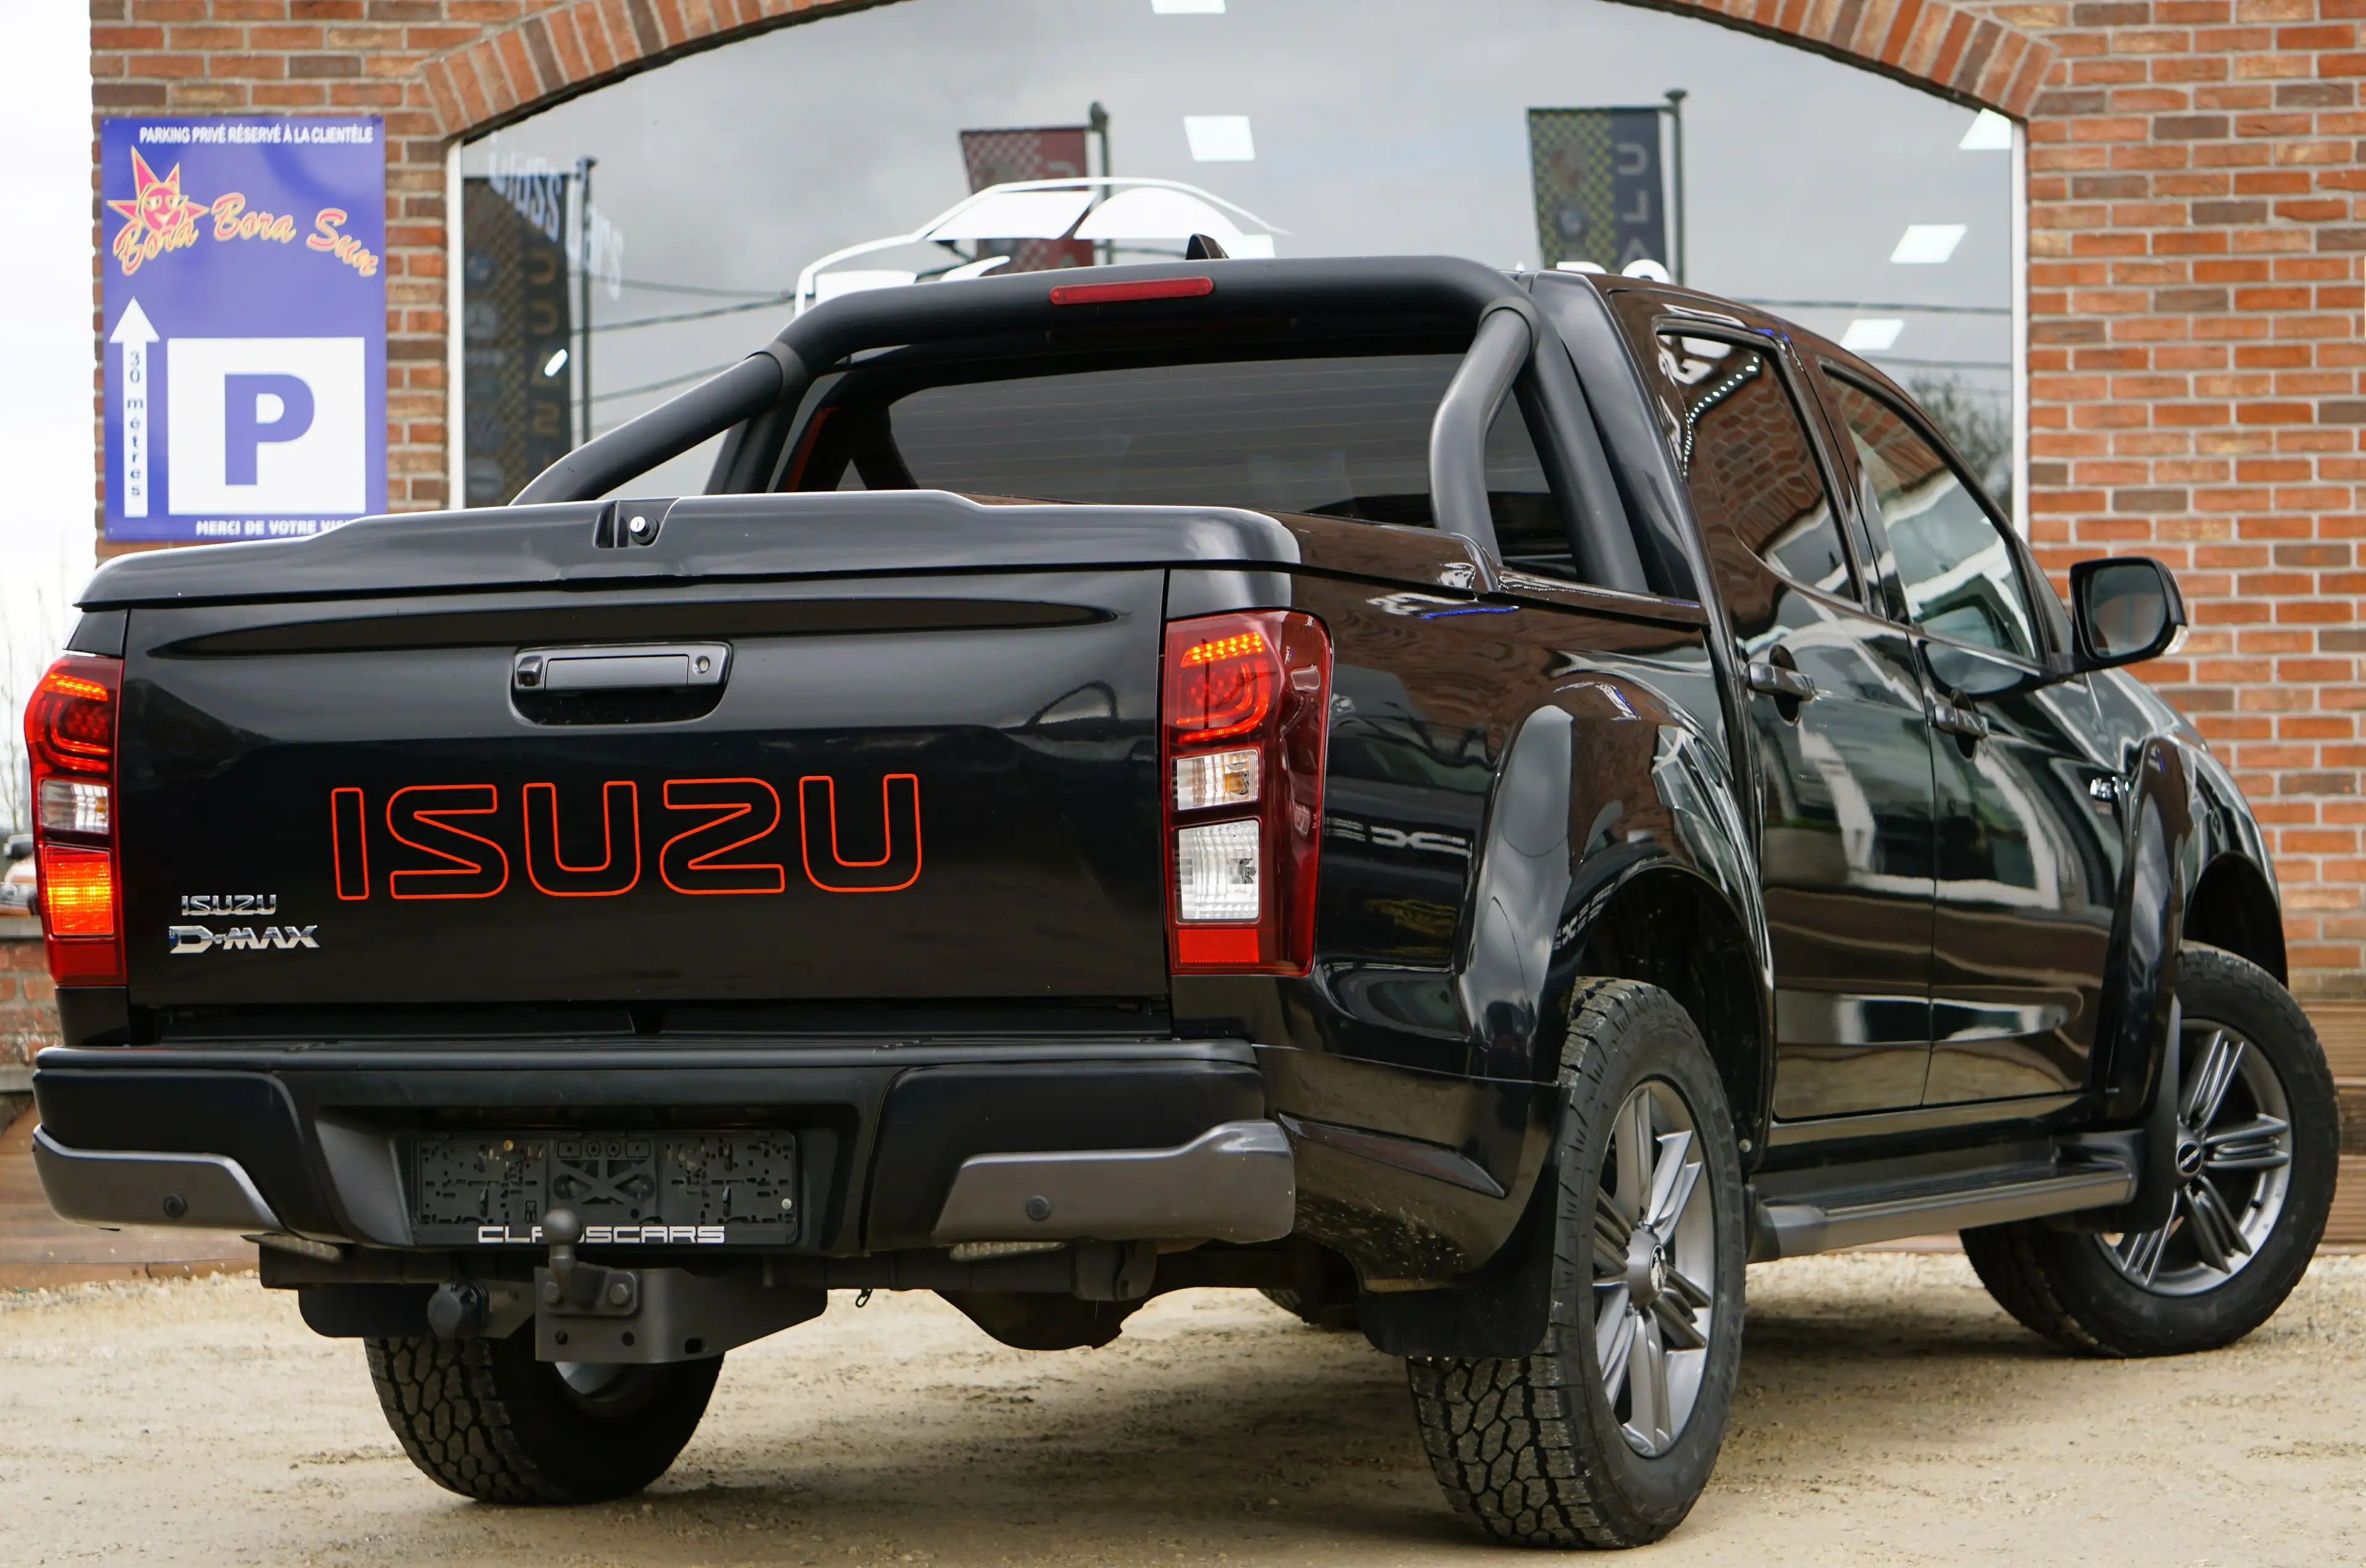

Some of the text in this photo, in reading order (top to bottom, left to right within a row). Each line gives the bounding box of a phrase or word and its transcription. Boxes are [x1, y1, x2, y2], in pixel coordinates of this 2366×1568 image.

[140, 123, 373, 144] PARKING PRIVÉ RÉSERVÉ À LA CLIENTÈLE
[113, 192, 378, 277] Bora Bora Sun
[129, 350, 140, 383] 30
[224, 374, 315, 485] P
[196, 519, 241, 535] MERCI
[245, 519, 265, 535] DE
[268, 519, 317, 535] VOTRE
[331, 773, 922, 900] ISUZU
[181, 894, 277, 916] ISUZU
[169, 925, 320, 954] D-MAX
